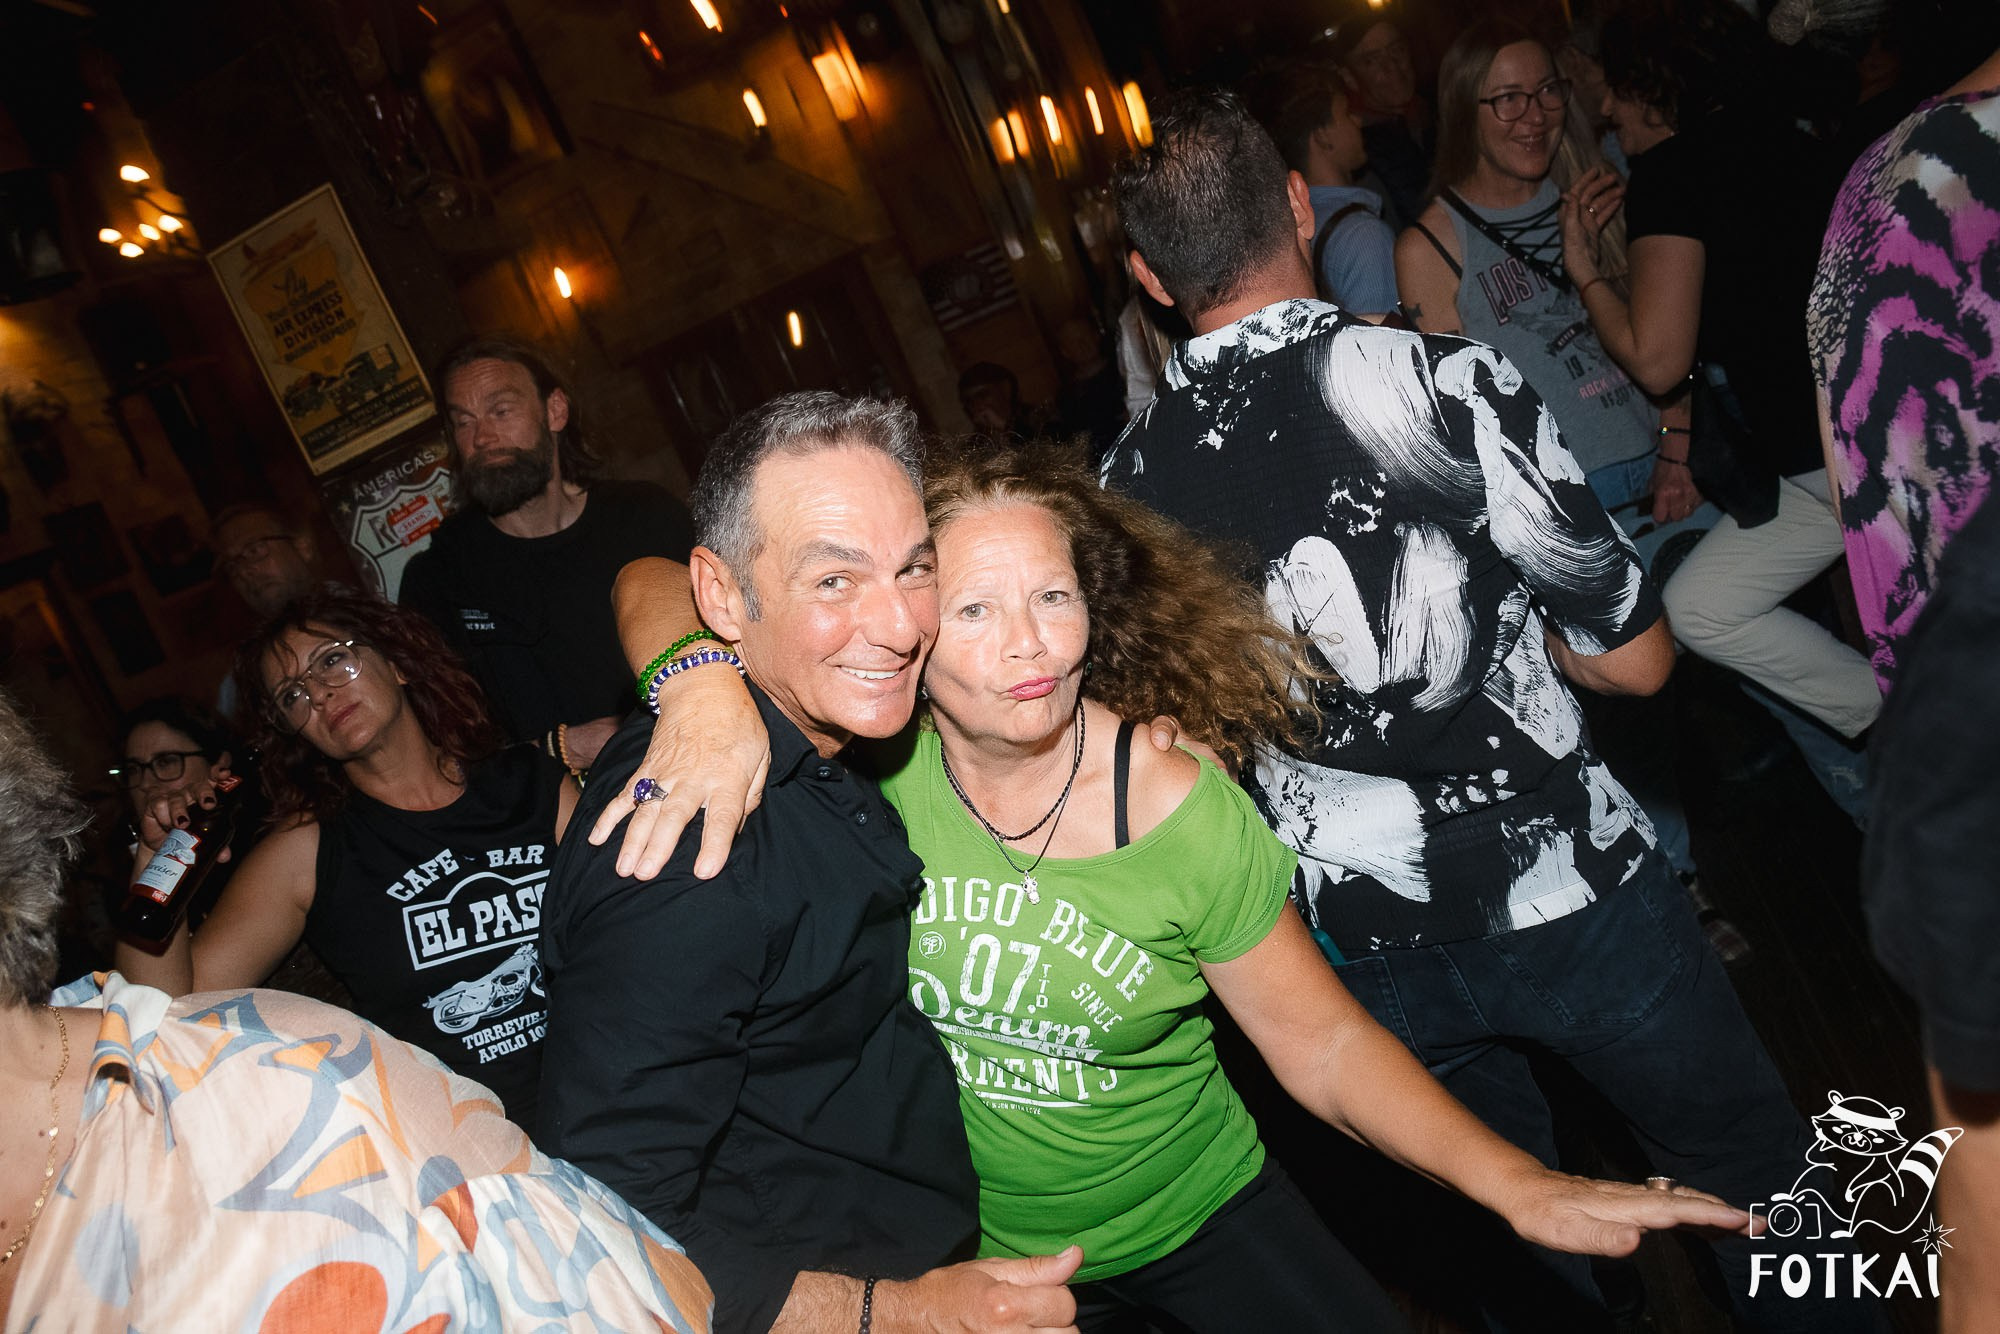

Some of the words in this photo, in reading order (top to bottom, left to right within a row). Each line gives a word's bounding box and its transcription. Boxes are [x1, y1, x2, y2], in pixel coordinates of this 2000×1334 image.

[274, 319, 294, 338] AIR
[293, 290, 343, 326] EXPRESS
[283, 306, 346, 349] DIVISION
[1579, 378, 1609, 400] ROCK
[386, 848, 460, 901] CAFE
[486, 844, 545, 868] BAR
[414, 908, 467, 958] EL
[1039, 898, 1155, 1003] BLUE
[1070, 981, 1123, 1033] SINCE
[479, 1033, 529, 1065] APOLO
[1048, 1046, 1087, 1060] NEW
